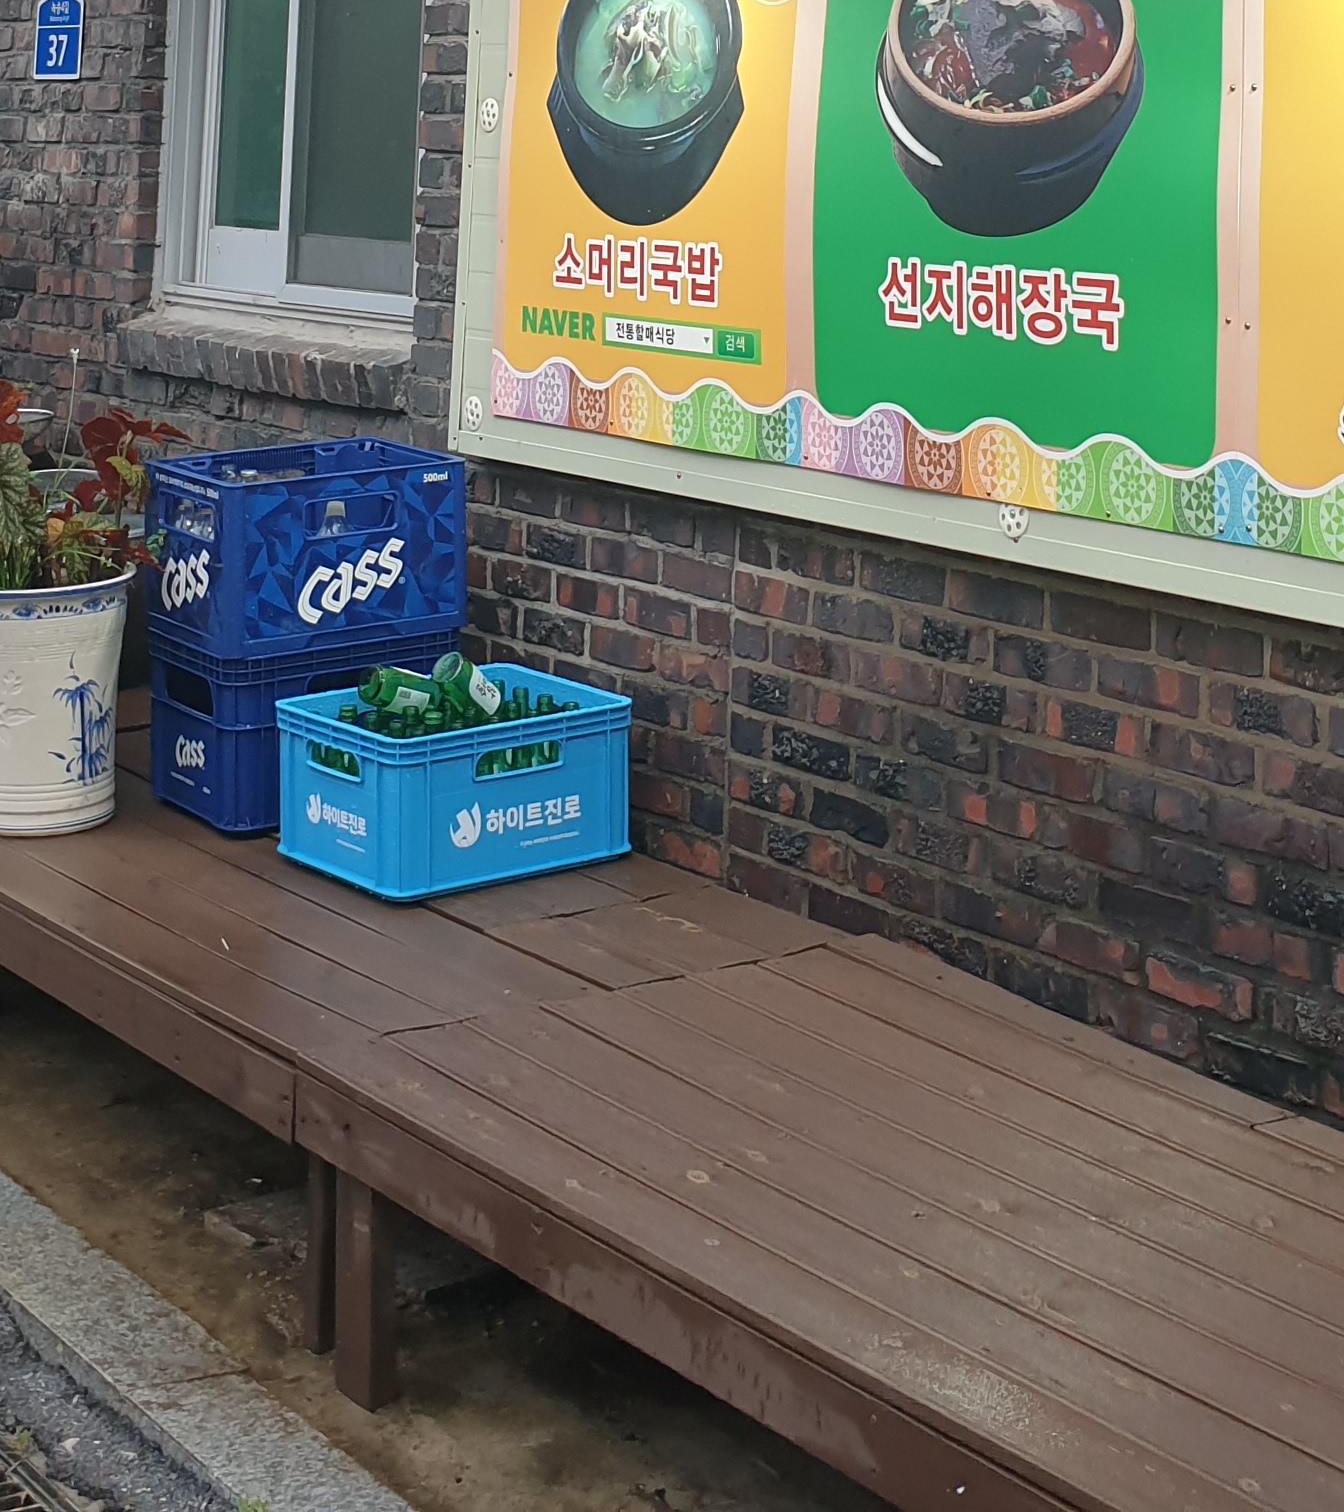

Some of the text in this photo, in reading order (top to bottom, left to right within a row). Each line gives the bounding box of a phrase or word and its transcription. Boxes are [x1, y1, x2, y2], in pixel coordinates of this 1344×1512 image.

[46, 34, 69, 67] 37
[554, 235, 721, 306] 소머리국밥
[881, 260, 1122, 348] 선지해장국
[522, 305, 596, 341] NAVER
[615, 322, 675, 345] 전통할매식당
[725, 334, 746, 353] 검색
[423, 470, 449, 483] 500ml
[297, 537, 405, 625] Cass
[175, 734, 205, 768] Cass
[322, 802, 367, 837] 하이트진로
[485, 794, 581, 835] 하이트진로
